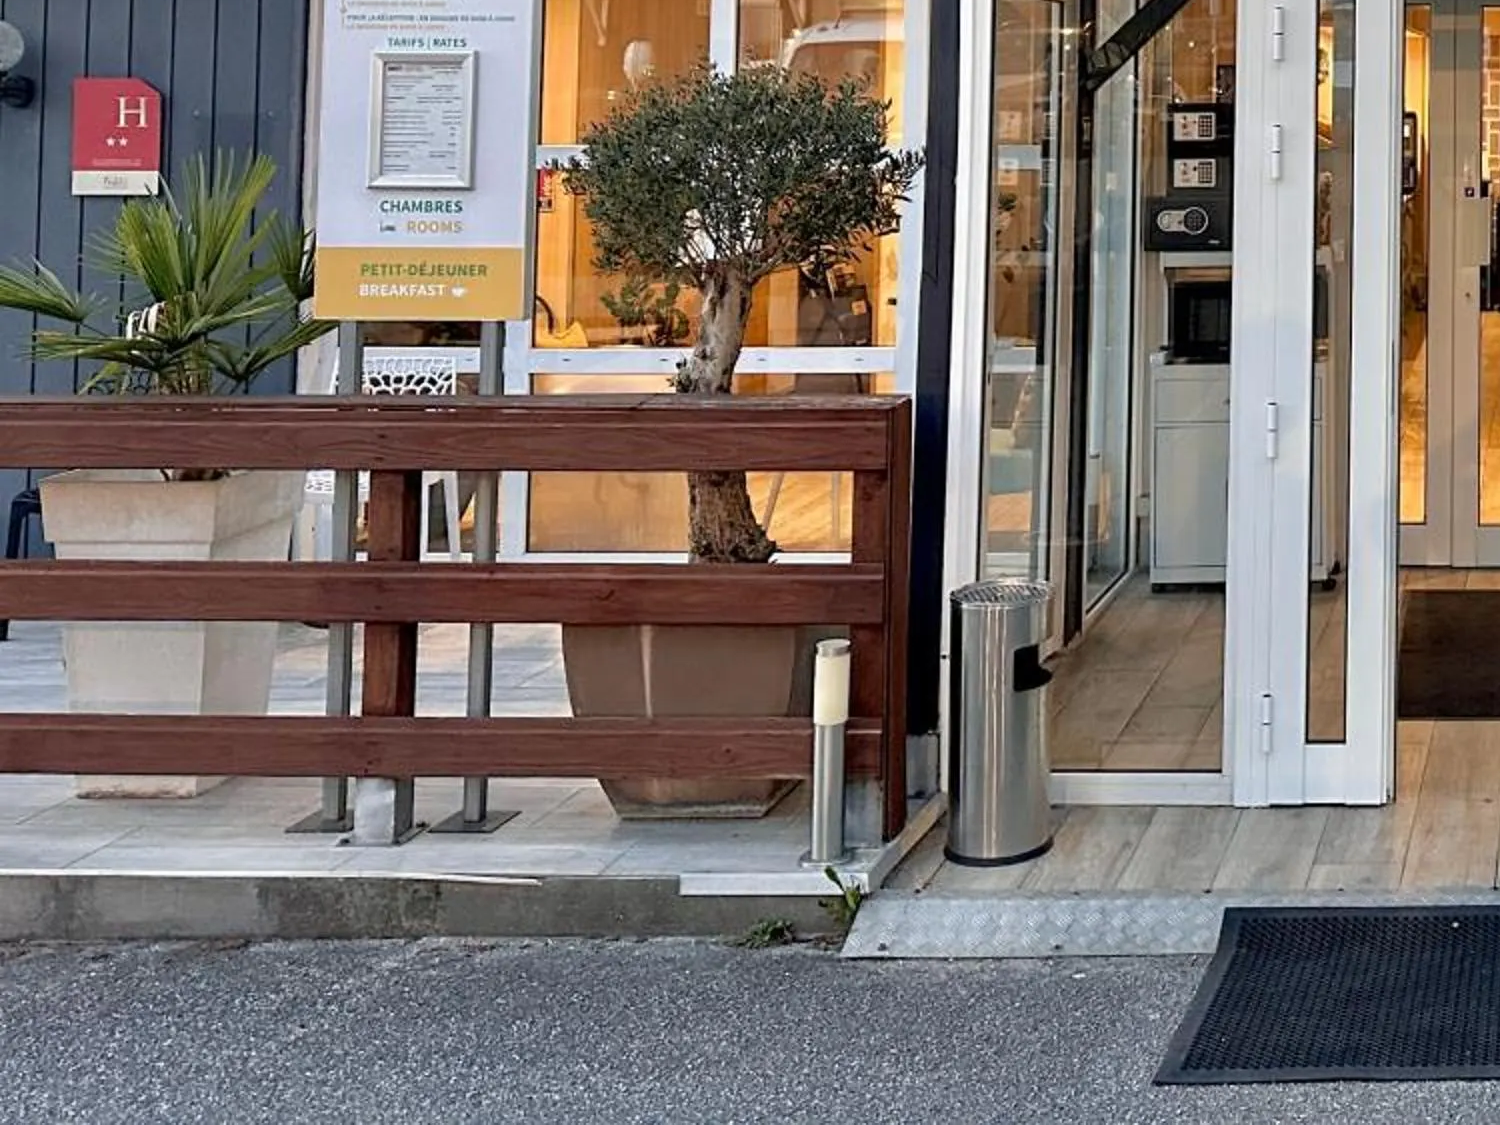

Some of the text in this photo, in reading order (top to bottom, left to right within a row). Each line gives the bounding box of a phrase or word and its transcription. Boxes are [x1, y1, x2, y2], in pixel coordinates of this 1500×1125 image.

[388, 37, 467, 48] TARIFS RATES
[115, 96, 148, 128] H
[380, 200, 463, 214] CHAMBRES
[407, 220, 463, 234] ROOMS
[361, 260, 487, 276] PETIT-DÉJEUNER
[359, 284, 445, 297] BREAKFAST
